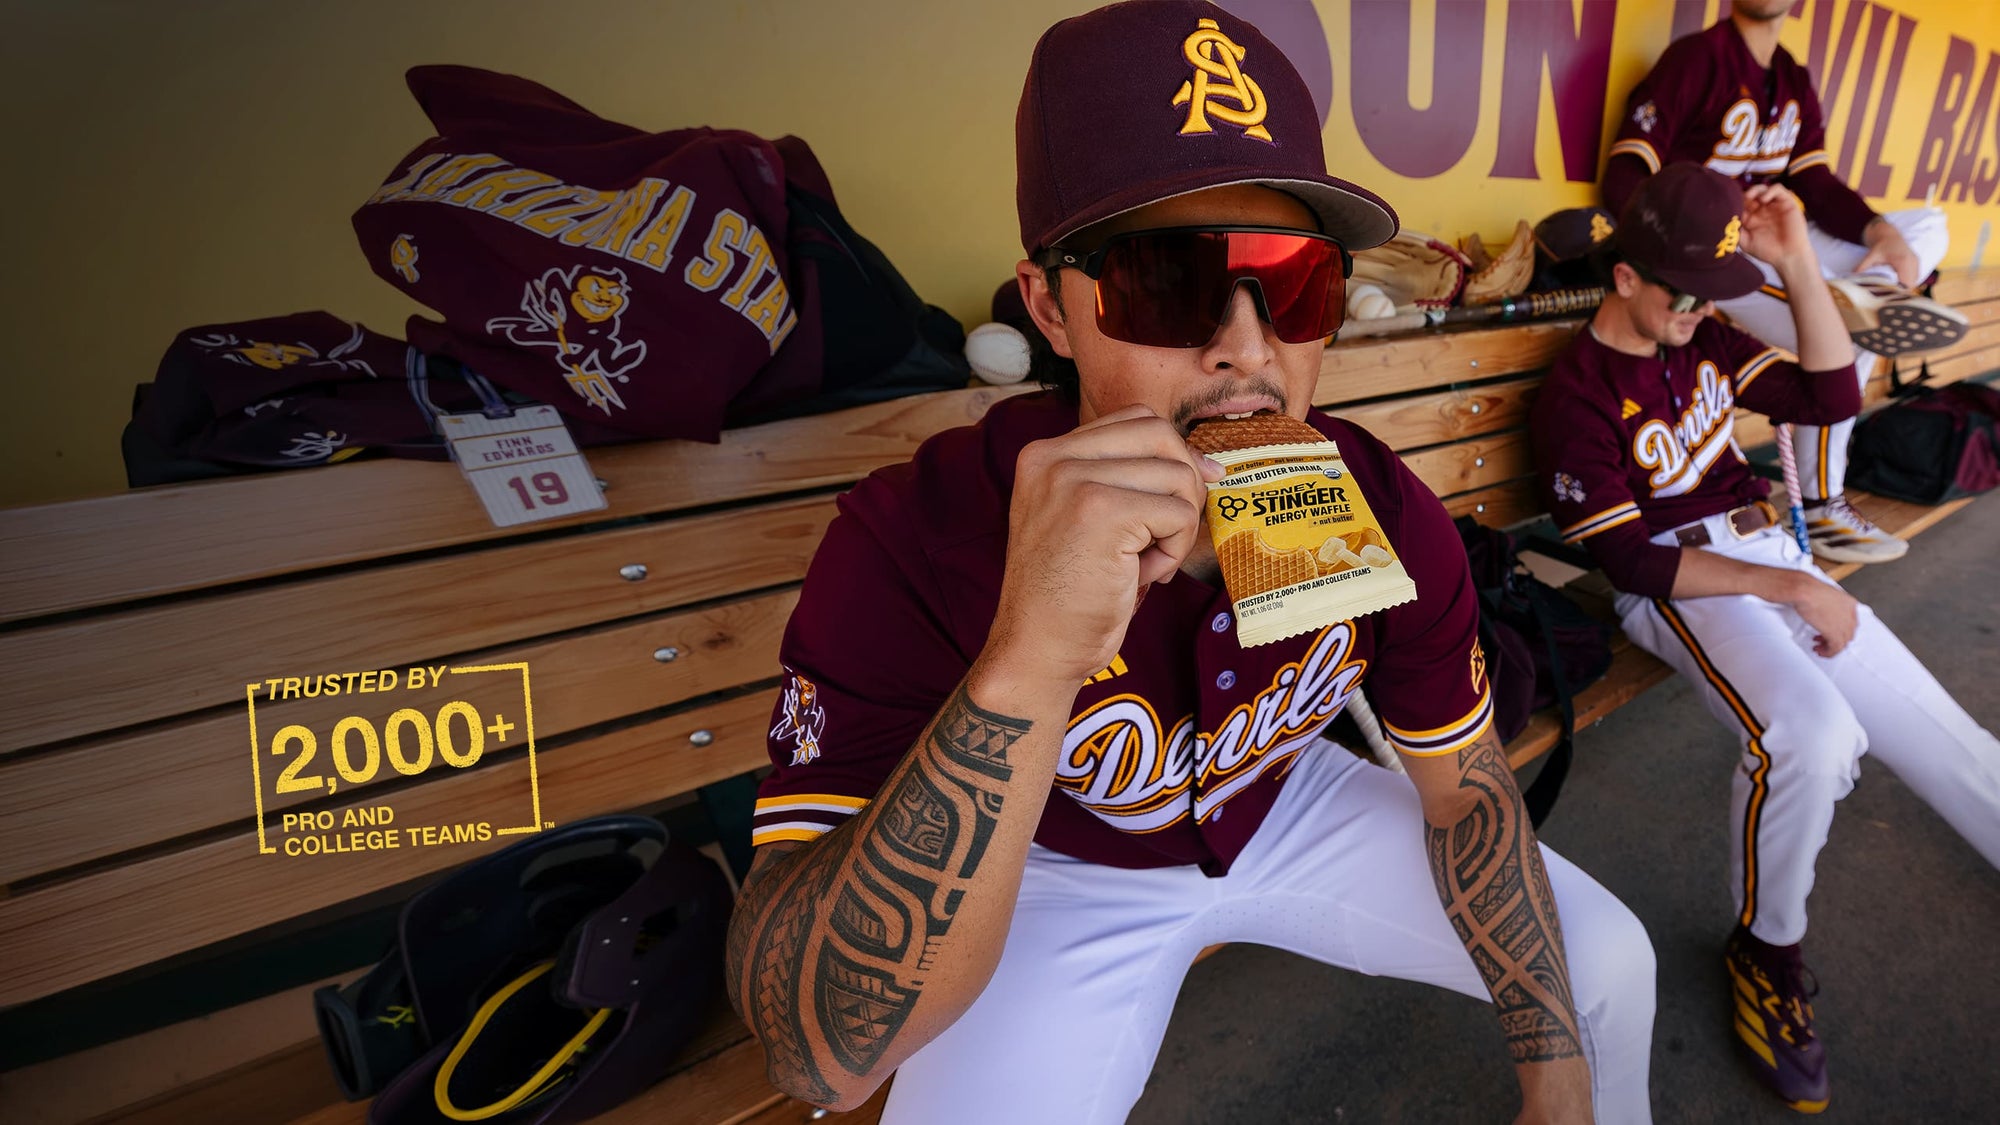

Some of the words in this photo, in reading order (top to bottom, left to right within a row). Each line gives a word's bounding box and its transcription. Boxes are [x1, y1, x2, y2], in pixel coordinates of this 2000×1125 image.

[482, 443, 555, 463] EDWARDS
[495, 435, 533, 449] FINN
[1219, 475, 1254, 487] PEANUT
[1255, 467, 1288, 481] BUTTER
[1289, 464, 1323, 474] BANANA
[507, 471, 569, 510] 19
[1251, 481, 1317, 498] HONEY
[1252, 487, 1346, 516] STINGER
[1265, 509, 1309, 527] ENERGY
[1309, 503, 1351, 517] WAFFLE
[1319, 517, 1331, 525] nut
[1331, 514, 1353, 524] butter
[1237, 595, 1265, 610] TRUSTED
[1266, 593, 1274, 602] BY
[1275, 587, 1297, 600] 2,000+
[1298, 583, 1311, 593] PRO
[1312, 579, 1325, 590] AND
[1325, 572, 1351, 585] COLLEGE
[1351, 566, 1371, 579] TEAMS
[1055, 619, 1367, 812] Devils
